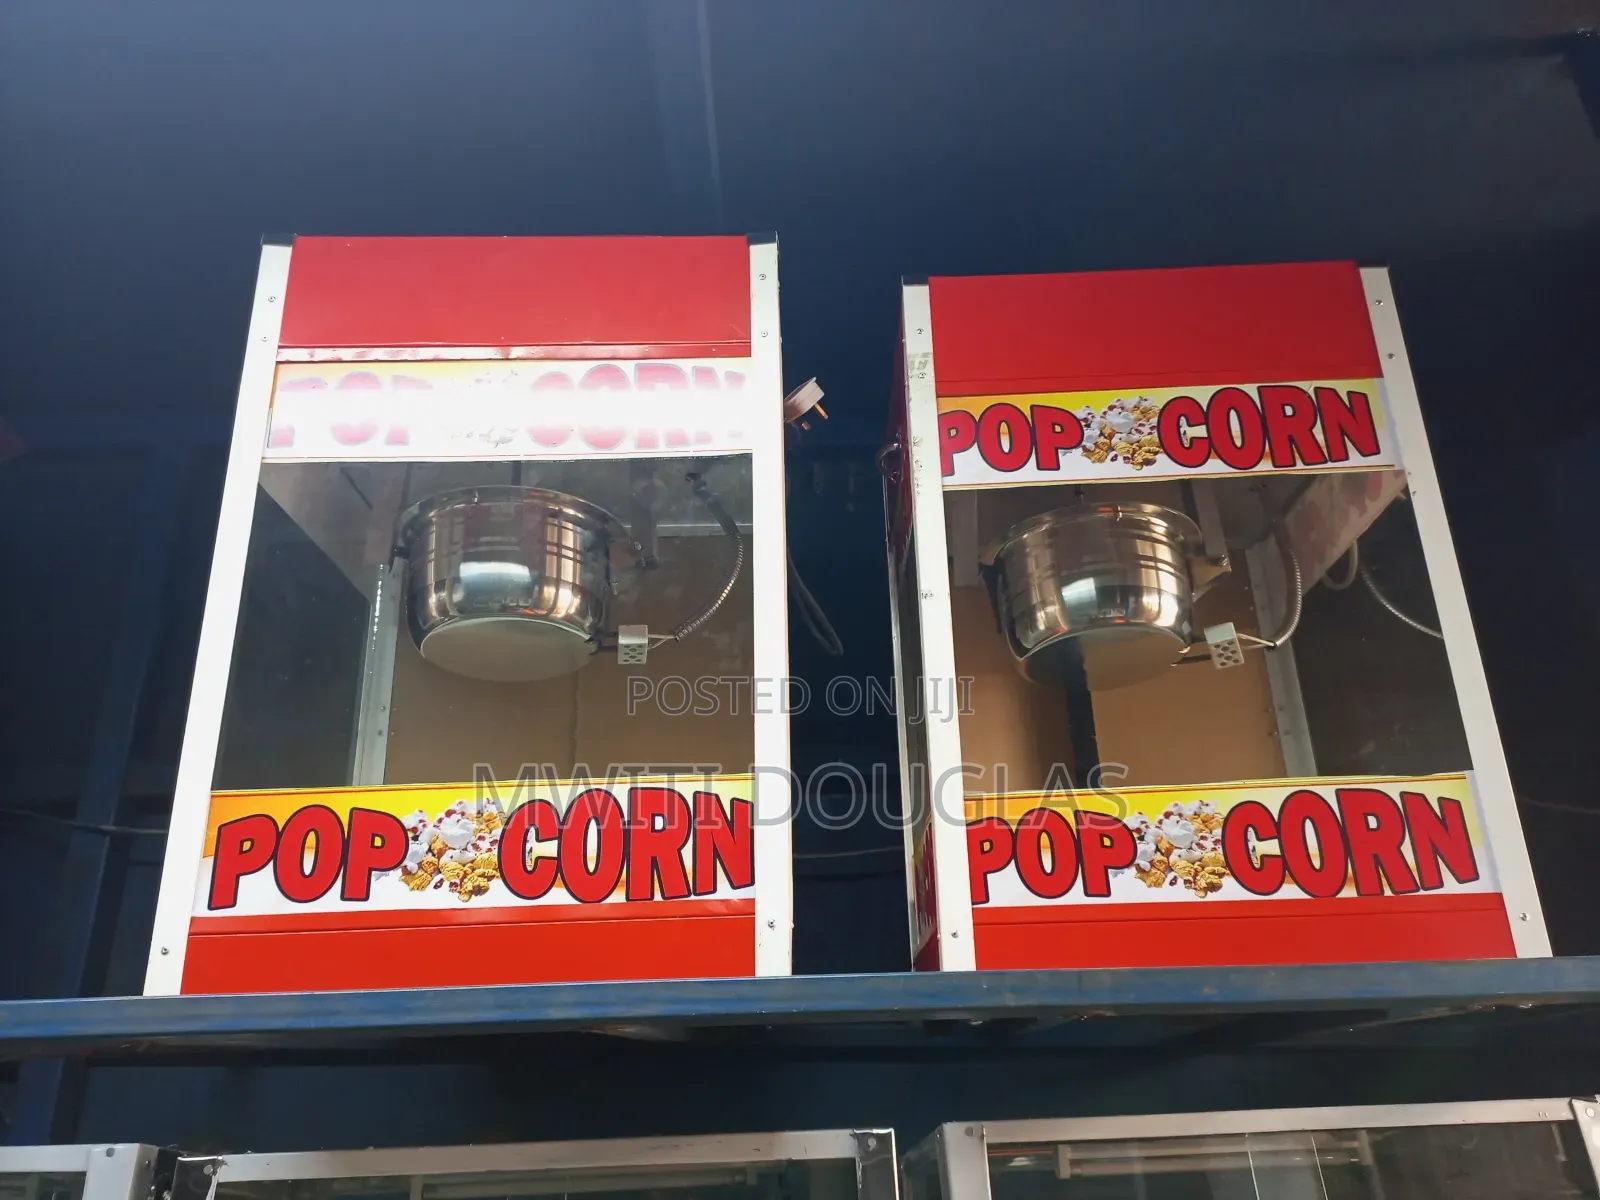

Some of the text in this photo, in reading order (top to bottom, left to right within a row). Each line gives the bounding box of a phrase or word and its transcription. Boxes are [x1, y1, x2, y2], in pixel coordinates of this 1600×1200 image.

[939, 385, 1380, 476] POP CORN
[208, 787, 755, 910] POP CORN
[966, 807, 1137, 905] POP
[1221, 789, 1479, 897] CORN
